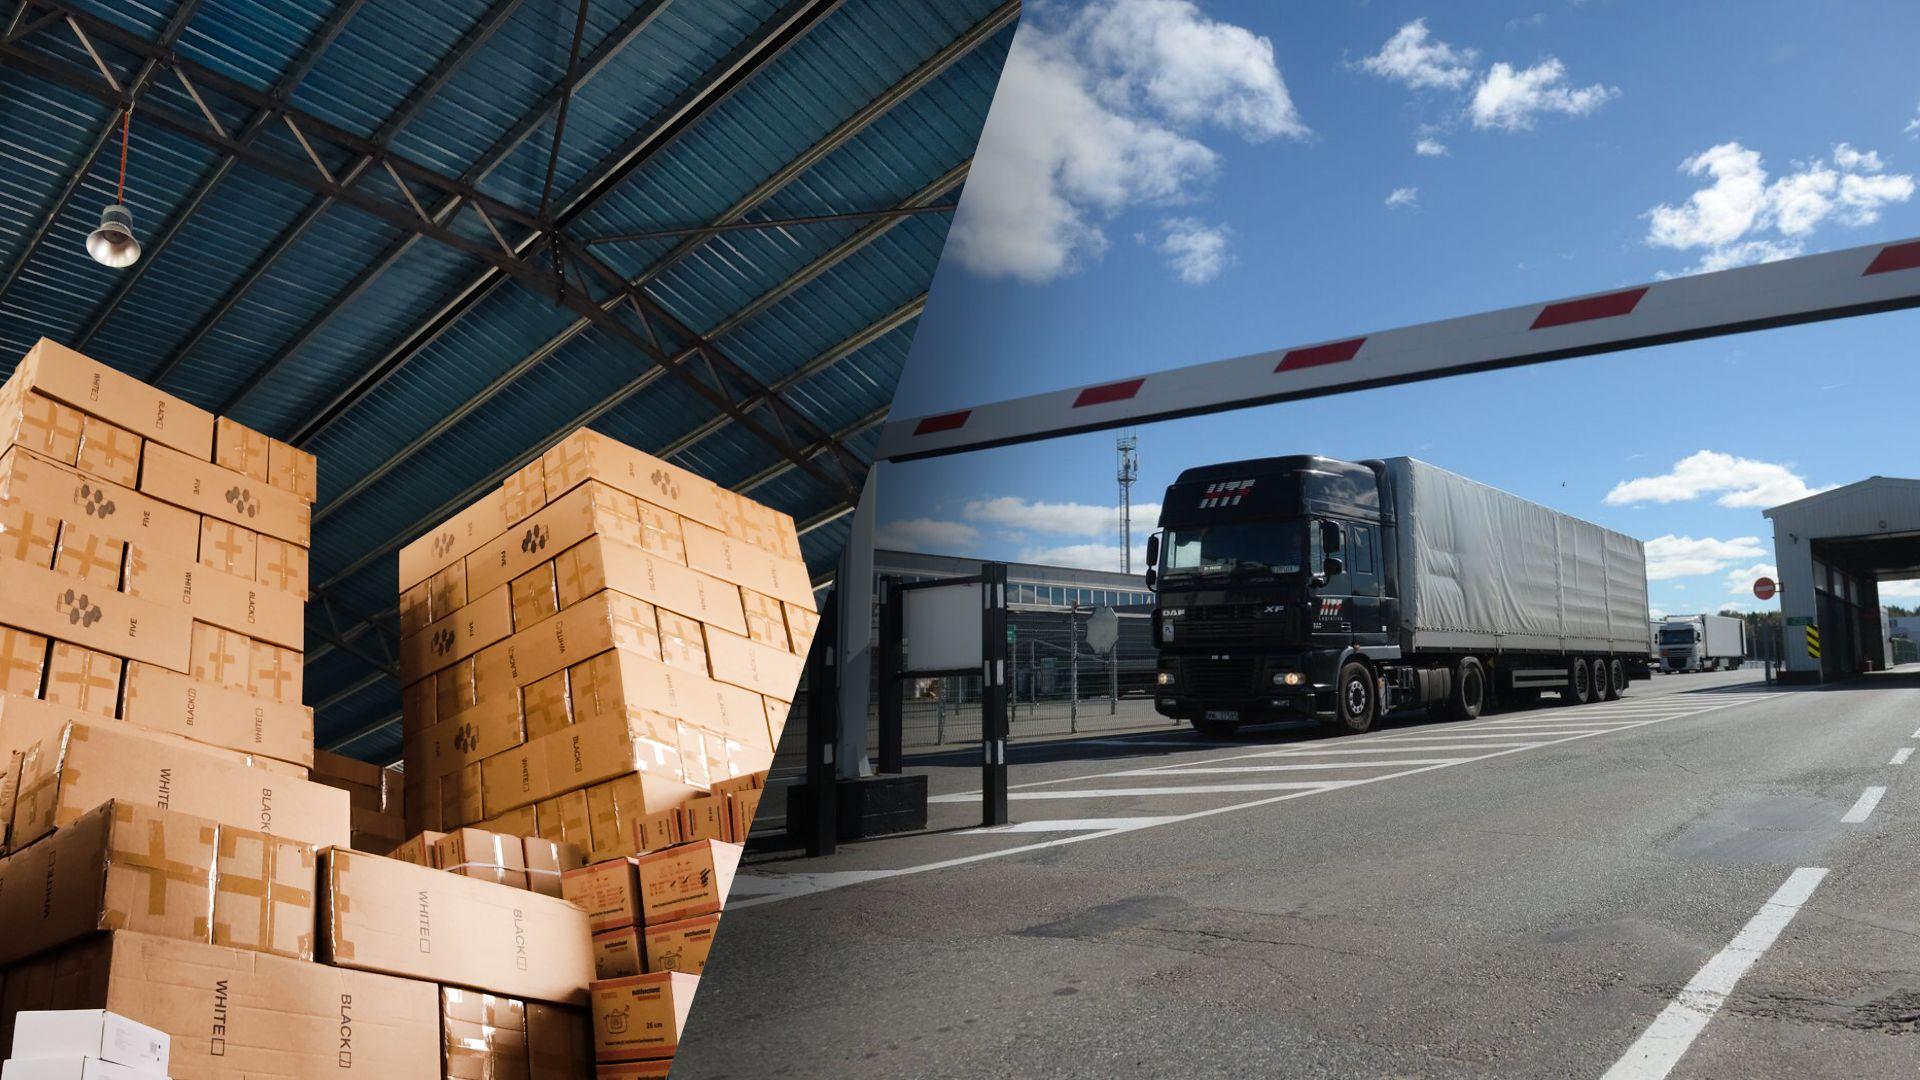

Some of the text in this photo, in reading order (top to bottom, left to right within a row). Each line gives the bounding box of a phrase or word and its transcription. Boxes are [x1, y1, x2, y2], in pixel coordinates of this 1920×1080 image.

[142, 510, 151, 527] FIVE
[184, 572, 192, 595] WHITE
[248, 591, 256, 615] BLACK
[1162, 609, 1185, 617] DAF
[1263, 605, 1285, 613] XF
[129, 617, 138, 638] FIVE
[186, 696, 196, 726] BLACK
[255, 716, 263, 743] WHITE
[572, 735, 581, 764] BLACK
[521, 757, 529, 784] WHITE
[157, 768, 171, 810] WHITE
[261, 787, 272, 830] BLACK
[418, 890, 430, 937] WHITE
[513, 908, 526, 955] BLACK
[212, 979, 228, 1036] WHITE
[340, 993, 351, 1049] BLACK
